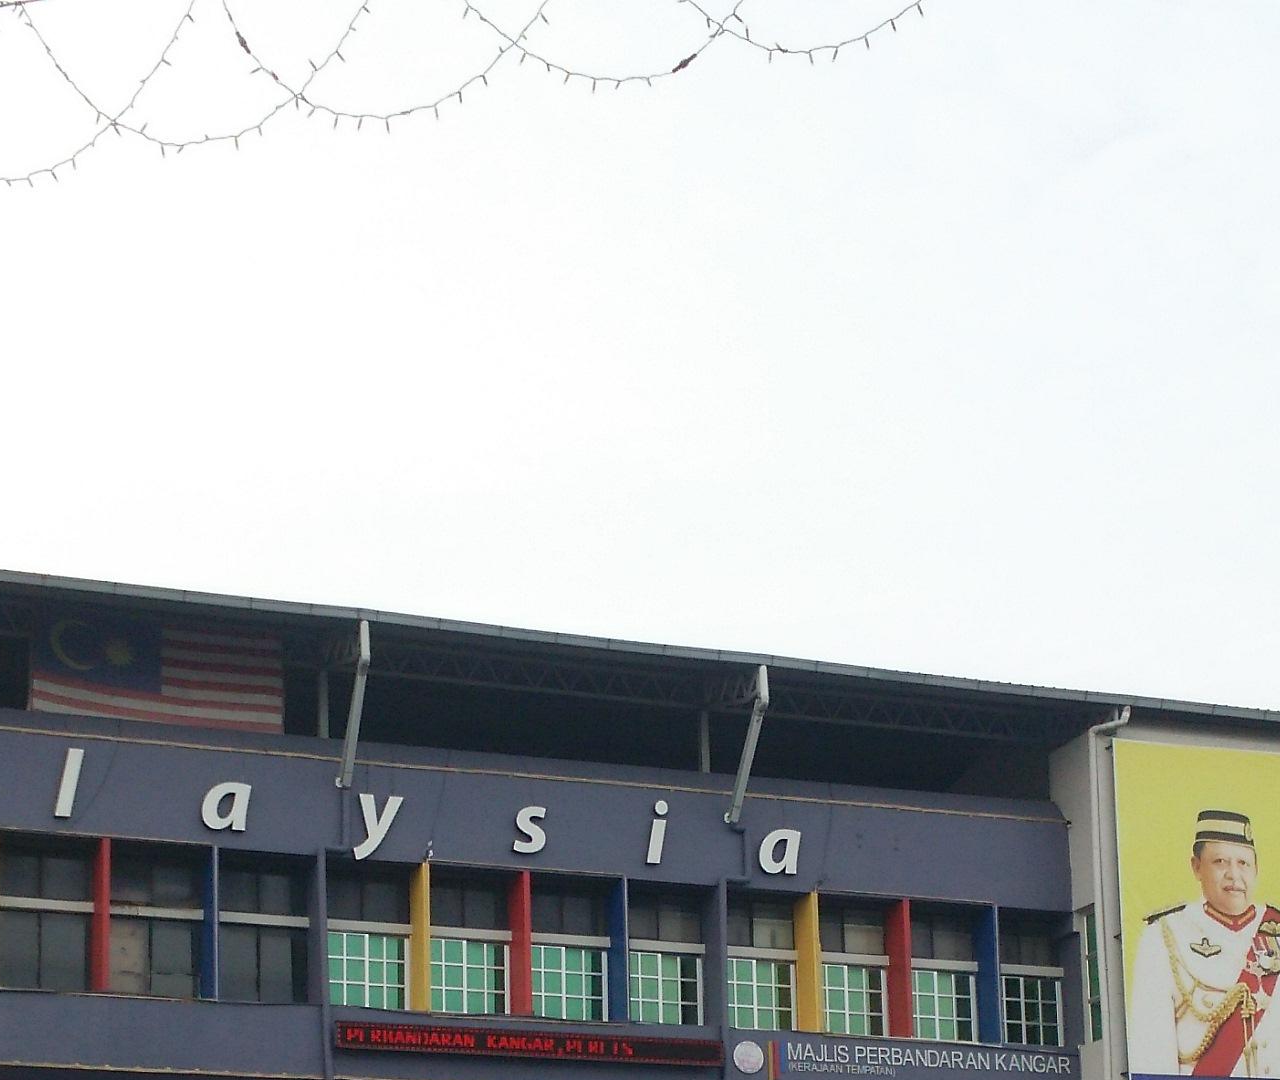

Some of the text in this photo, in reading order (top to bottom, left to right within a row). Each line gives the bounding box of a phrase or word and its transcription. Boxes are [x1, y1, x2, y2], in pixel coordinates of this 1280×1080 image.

[786, 1042, 1071, 1075] MAJLIS PERBANDARAN KANGAR
[788, 1062, 896, 1078] (KERAJAAN TEMPATAN)
